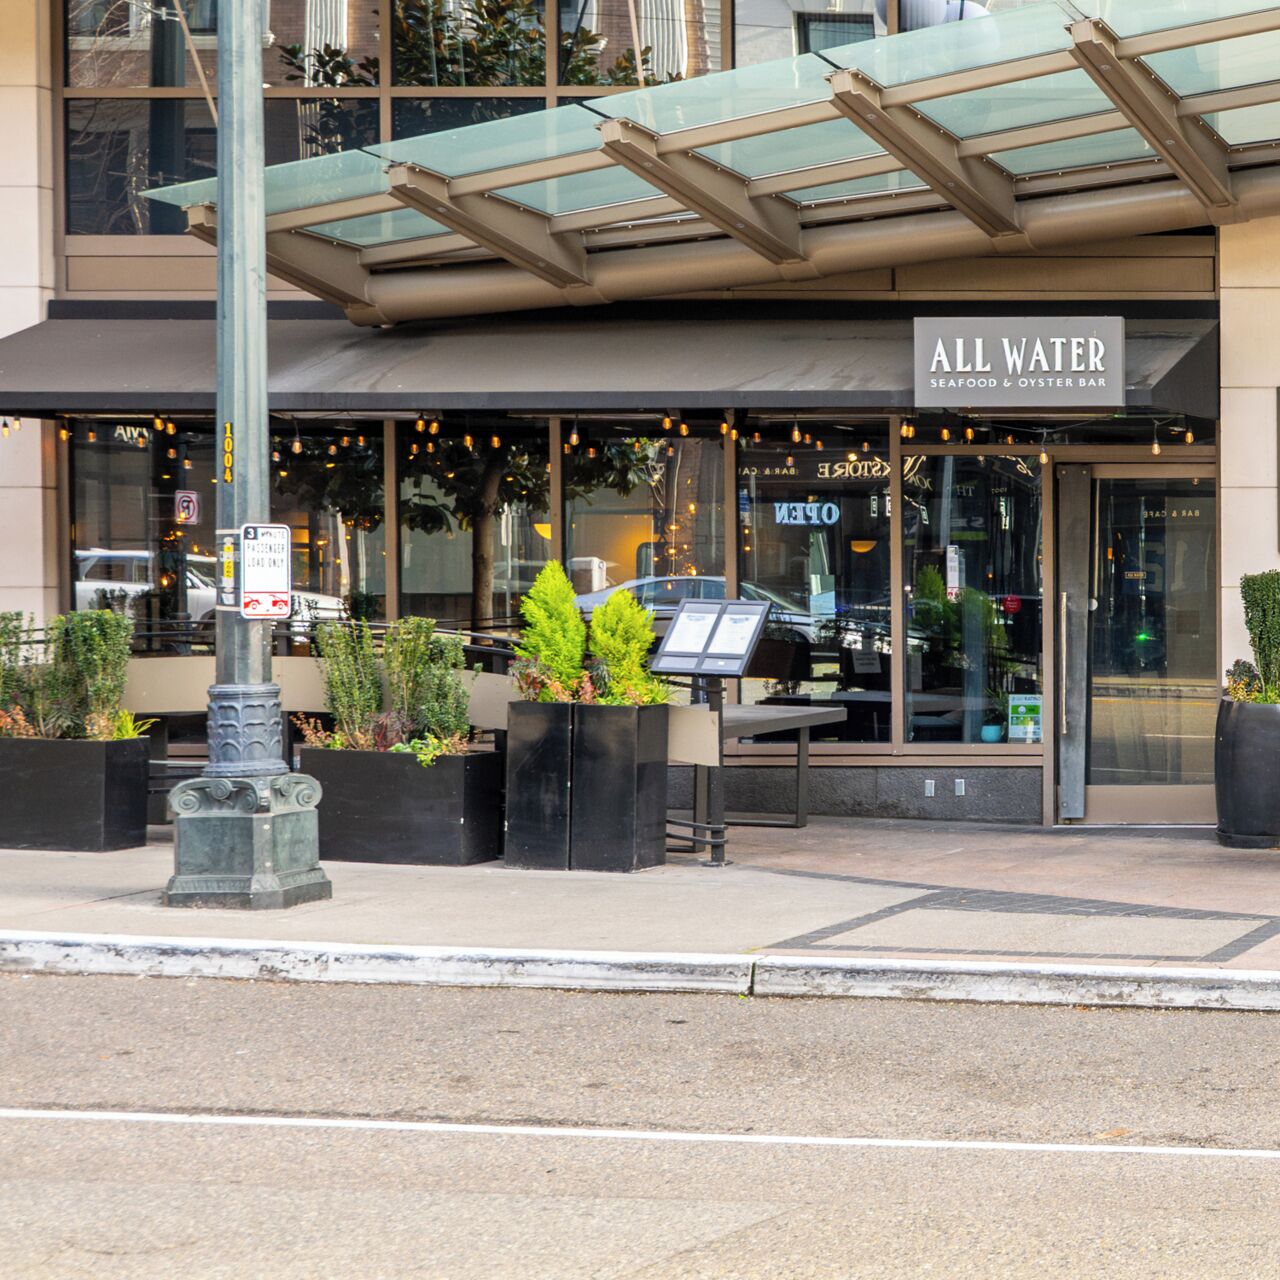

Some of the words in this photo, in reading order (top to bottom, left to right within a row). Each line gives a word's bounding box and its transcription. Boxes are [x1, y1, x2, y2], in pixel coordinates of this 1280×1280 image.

[930, 336, 992, 373] ALL
[1001, 336, 1106, 376] WATER
[930, 377, 998, 389] SEAFOOD
[1003, 377, 1013, 388] &
[1018, 377, 1074, 388] OYSTER
[1079, 377, 1107, 387] BAR
[224, 422, 234, 483] 1004
[247, 528, 255, 539] 3
